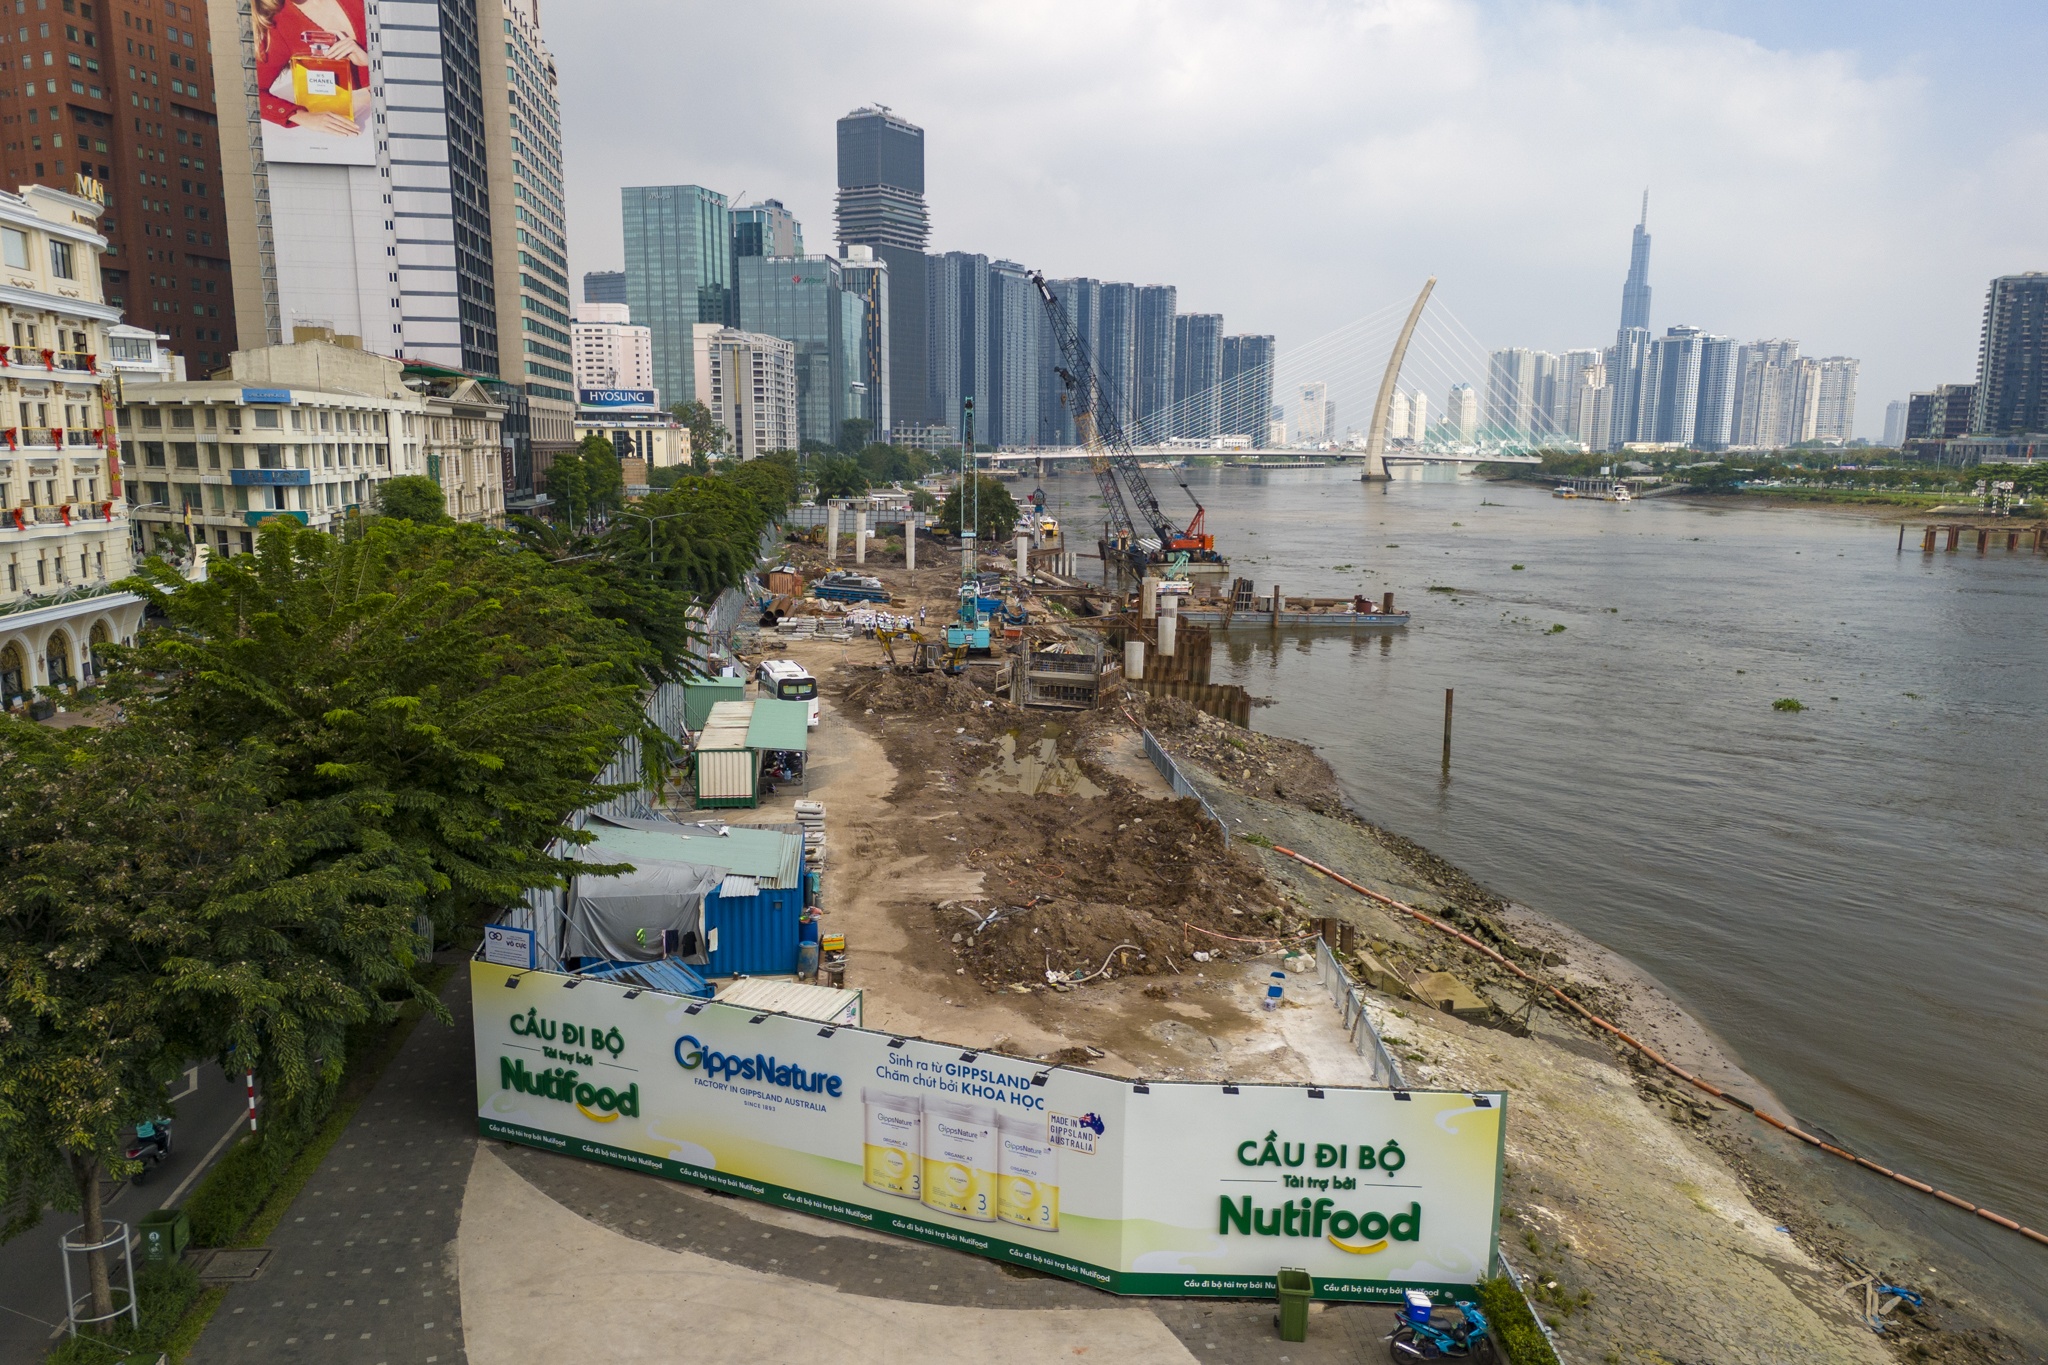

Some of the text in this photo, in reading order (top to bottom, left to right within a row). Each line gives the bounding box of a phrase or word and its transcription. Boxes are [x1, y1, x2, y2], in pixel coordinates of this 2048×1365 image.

[590, 392, 644, 402] HYOSUNG
[510, 1007, 625, 1059] CẦU ĐI BỘ
[559, 1050, 574, 1065] trợ
[674, 1035, 842, 1098] GippsNature
[889, 1052, 1030, 1090] Sinh ra từ GIPPSLAND
[500, 1056, 640, 1118] Nutifood
[876, 1066, 1044, 1111] Chăm chút bởi KHOA HỌC
[694, 1078, 728, 1091] FACTORY
[740, 1088, 782, 1103] GIPPSLAND
[784, 1097, 826, 1112] AUSTRALIA
[744, 1101, 761, 1109] SINCE
[878, 1113, 912, 1126] GippsNature
[1051, 1115, 1077, 1128] MADE IN
[938, 1123, 978, 1138] GippsNature
[1050, 1125, 1093, 1141] GIPPSLAND
[543, 1136, 566, 1146] Nutifood
[1004, 1140, 1042, 1155] GippsNature
[1050, 1135, 1092, 1152] AUSTRALIA
[944, 1151, 965, 1160] ORGANIC
[1237, 1129, 1406, 1177] CẦU ĐI BỘ
[638, 1157, 662, 1169] Nutifood
[739, 1182, 764, 1194] Nutifood
[912, 1175, 920, 1190] 3
[1283, 1174, 1356, 1192] Tài trợ bởi
[978, 1194, 986, 1210] 3
[845, 1208, 872, 1221] Nutifood
[1042, 1206, 1049, 1221] 3
[1219, 1195, 1421, 1242] Nutifood
[959, 1236, 988, 1249] Nutifood
[1080, 1267, 1110, 1282] Nutifood
